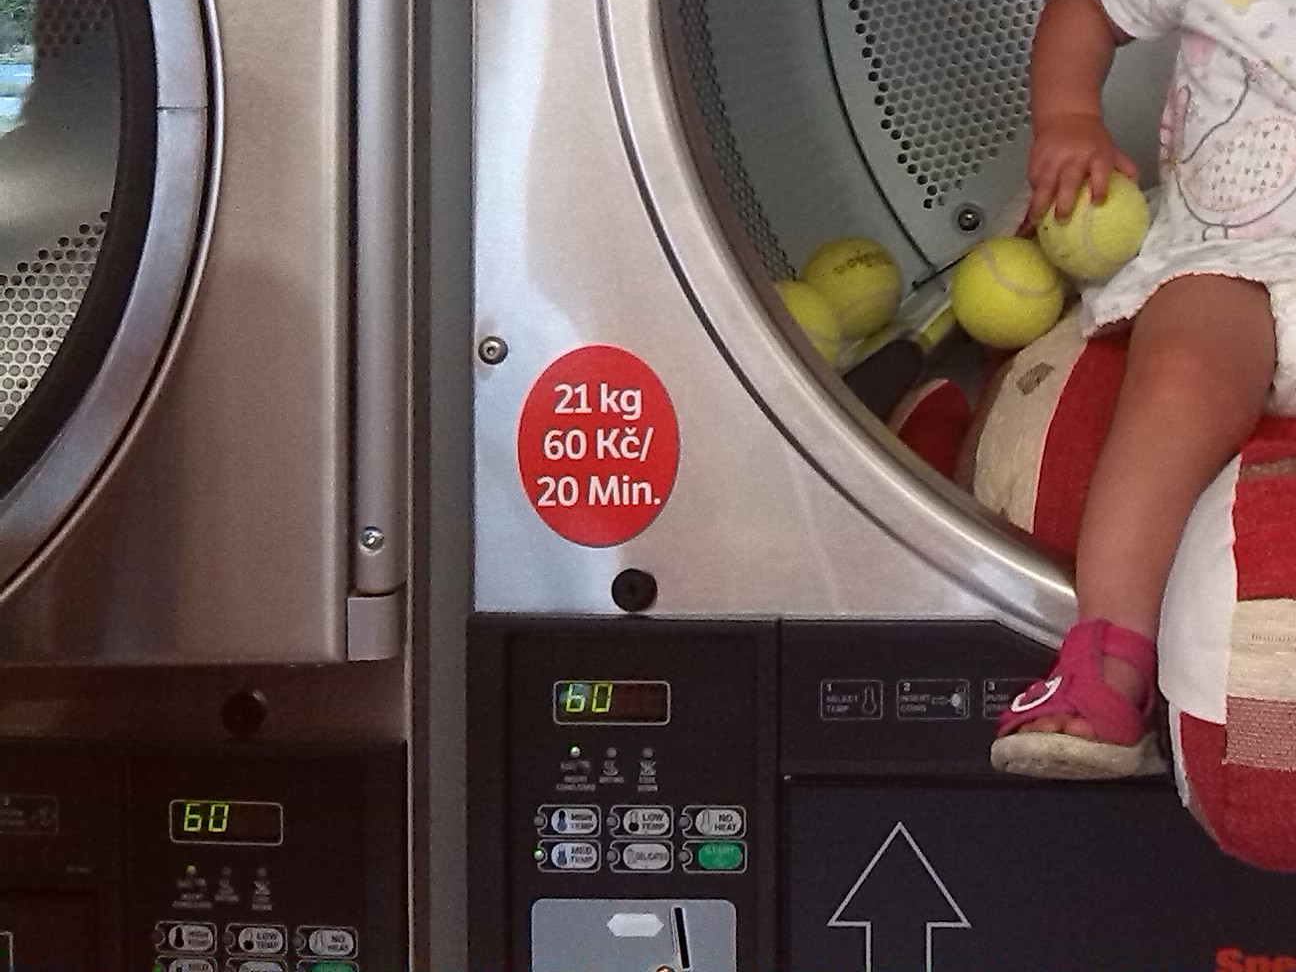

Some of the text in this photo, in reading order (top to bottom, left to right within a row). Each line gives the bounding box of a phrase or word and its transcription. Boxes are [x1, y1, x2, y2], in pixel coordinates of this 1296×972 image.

[554, 382, 642, 421] 21 kg
[543, 427, 654, 462] 60 Kč/
[536, 475, 662, 507] 20 Min.
[826, 682, 833, 692] 1
[903, 682, 912, 692] 2
[987, 681, 996, 691] 3
[565, 683, 614, 713] 60
[183, 802, 229, 833] 60
[641, 814, 664, 822] LOW
[718, 814, 733, 823] NO
[331, 935, 345, 943] NO
